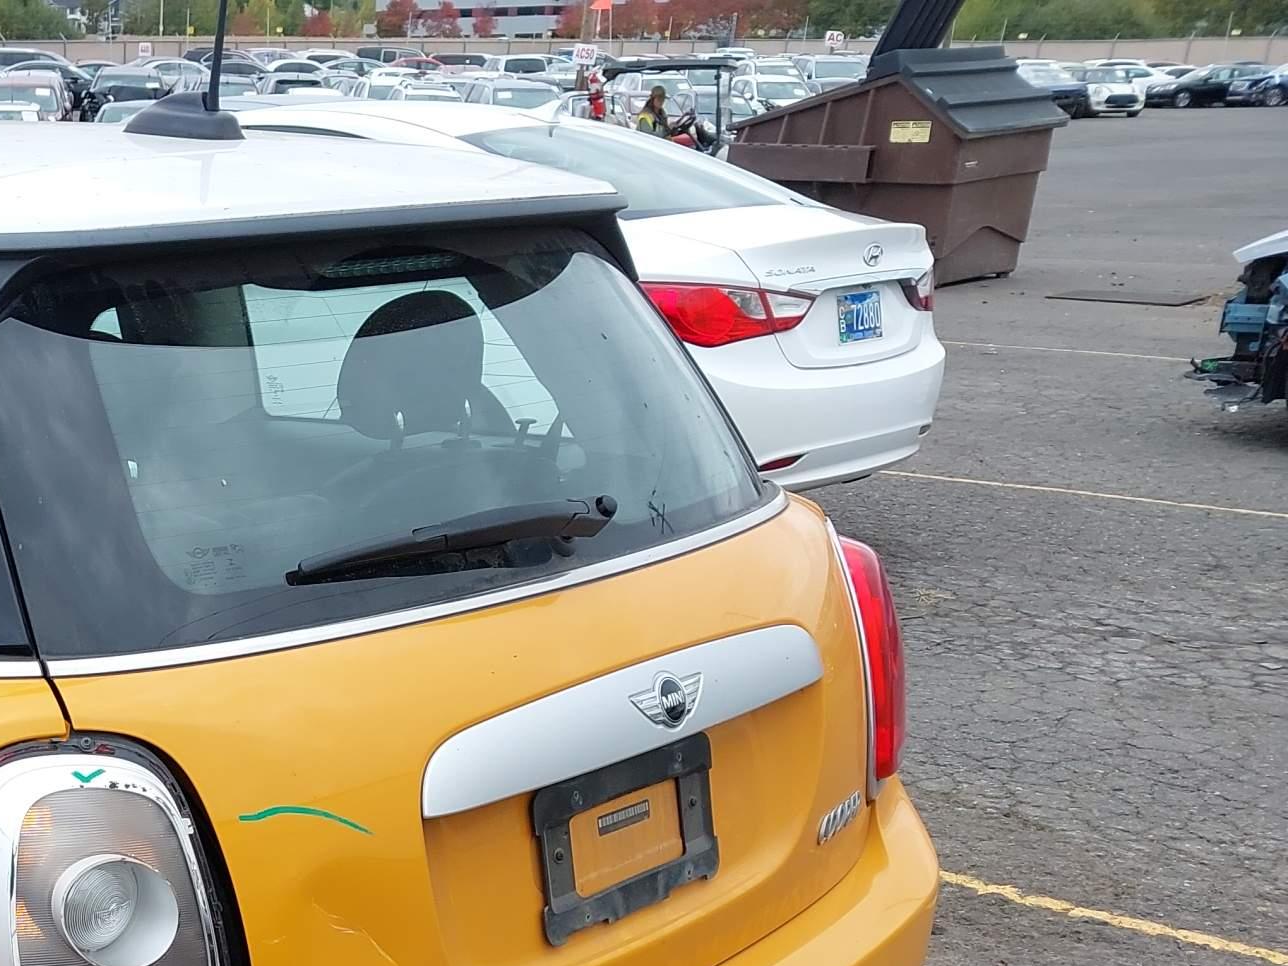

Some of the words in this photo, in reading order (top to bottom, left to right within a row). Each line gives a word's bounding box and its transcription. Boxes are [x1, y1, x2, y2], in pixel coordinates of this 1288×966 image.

[765, 266, 816, 277] SONATA
[851, 302, 881, 331] 72880
[661, 690, 685, 710] MINI
